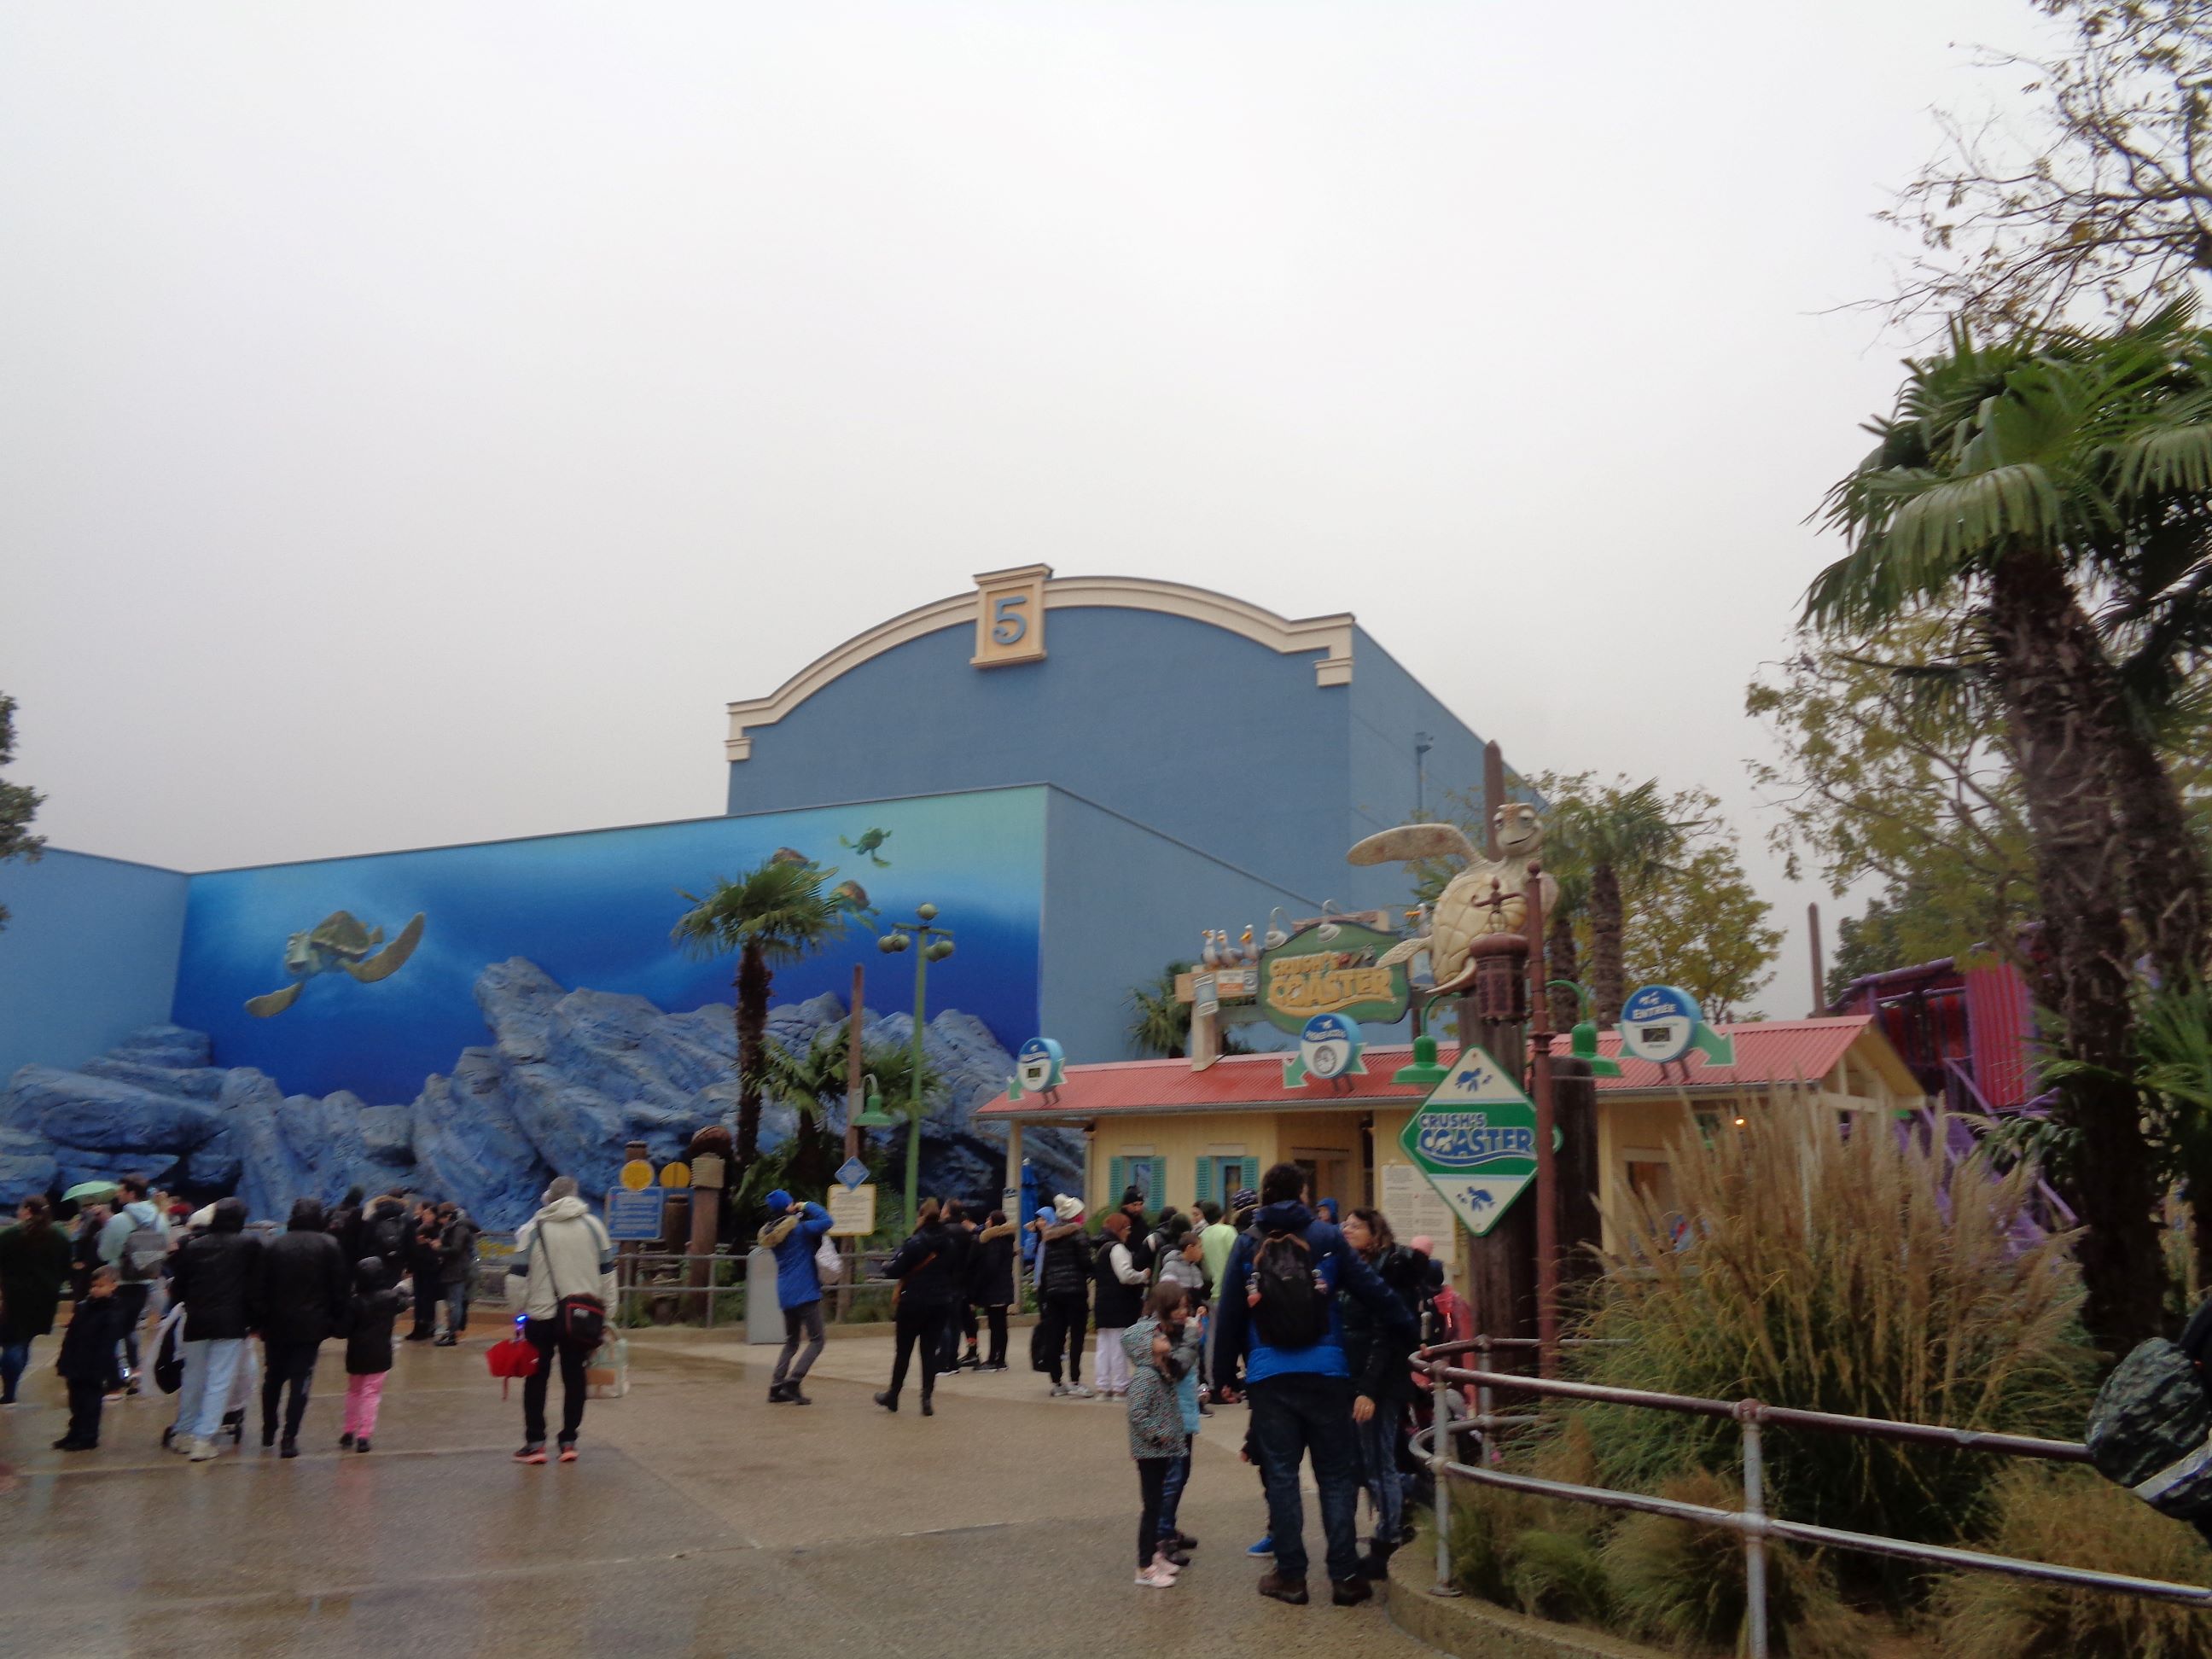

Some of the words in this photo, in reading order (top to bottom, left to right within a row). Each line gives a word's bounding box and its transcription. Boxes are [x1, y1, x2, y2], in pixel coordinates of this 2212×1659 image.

[992, 595, 1027, 645] 5
[1270, 952, 1339, 977] CRUSH'S
[1268, 967, 1394, 1008] COASTER
[1419, 1113, 1486, 1128] CRUSH'S
[1418, 1127, 1534, 1157] COASTER
